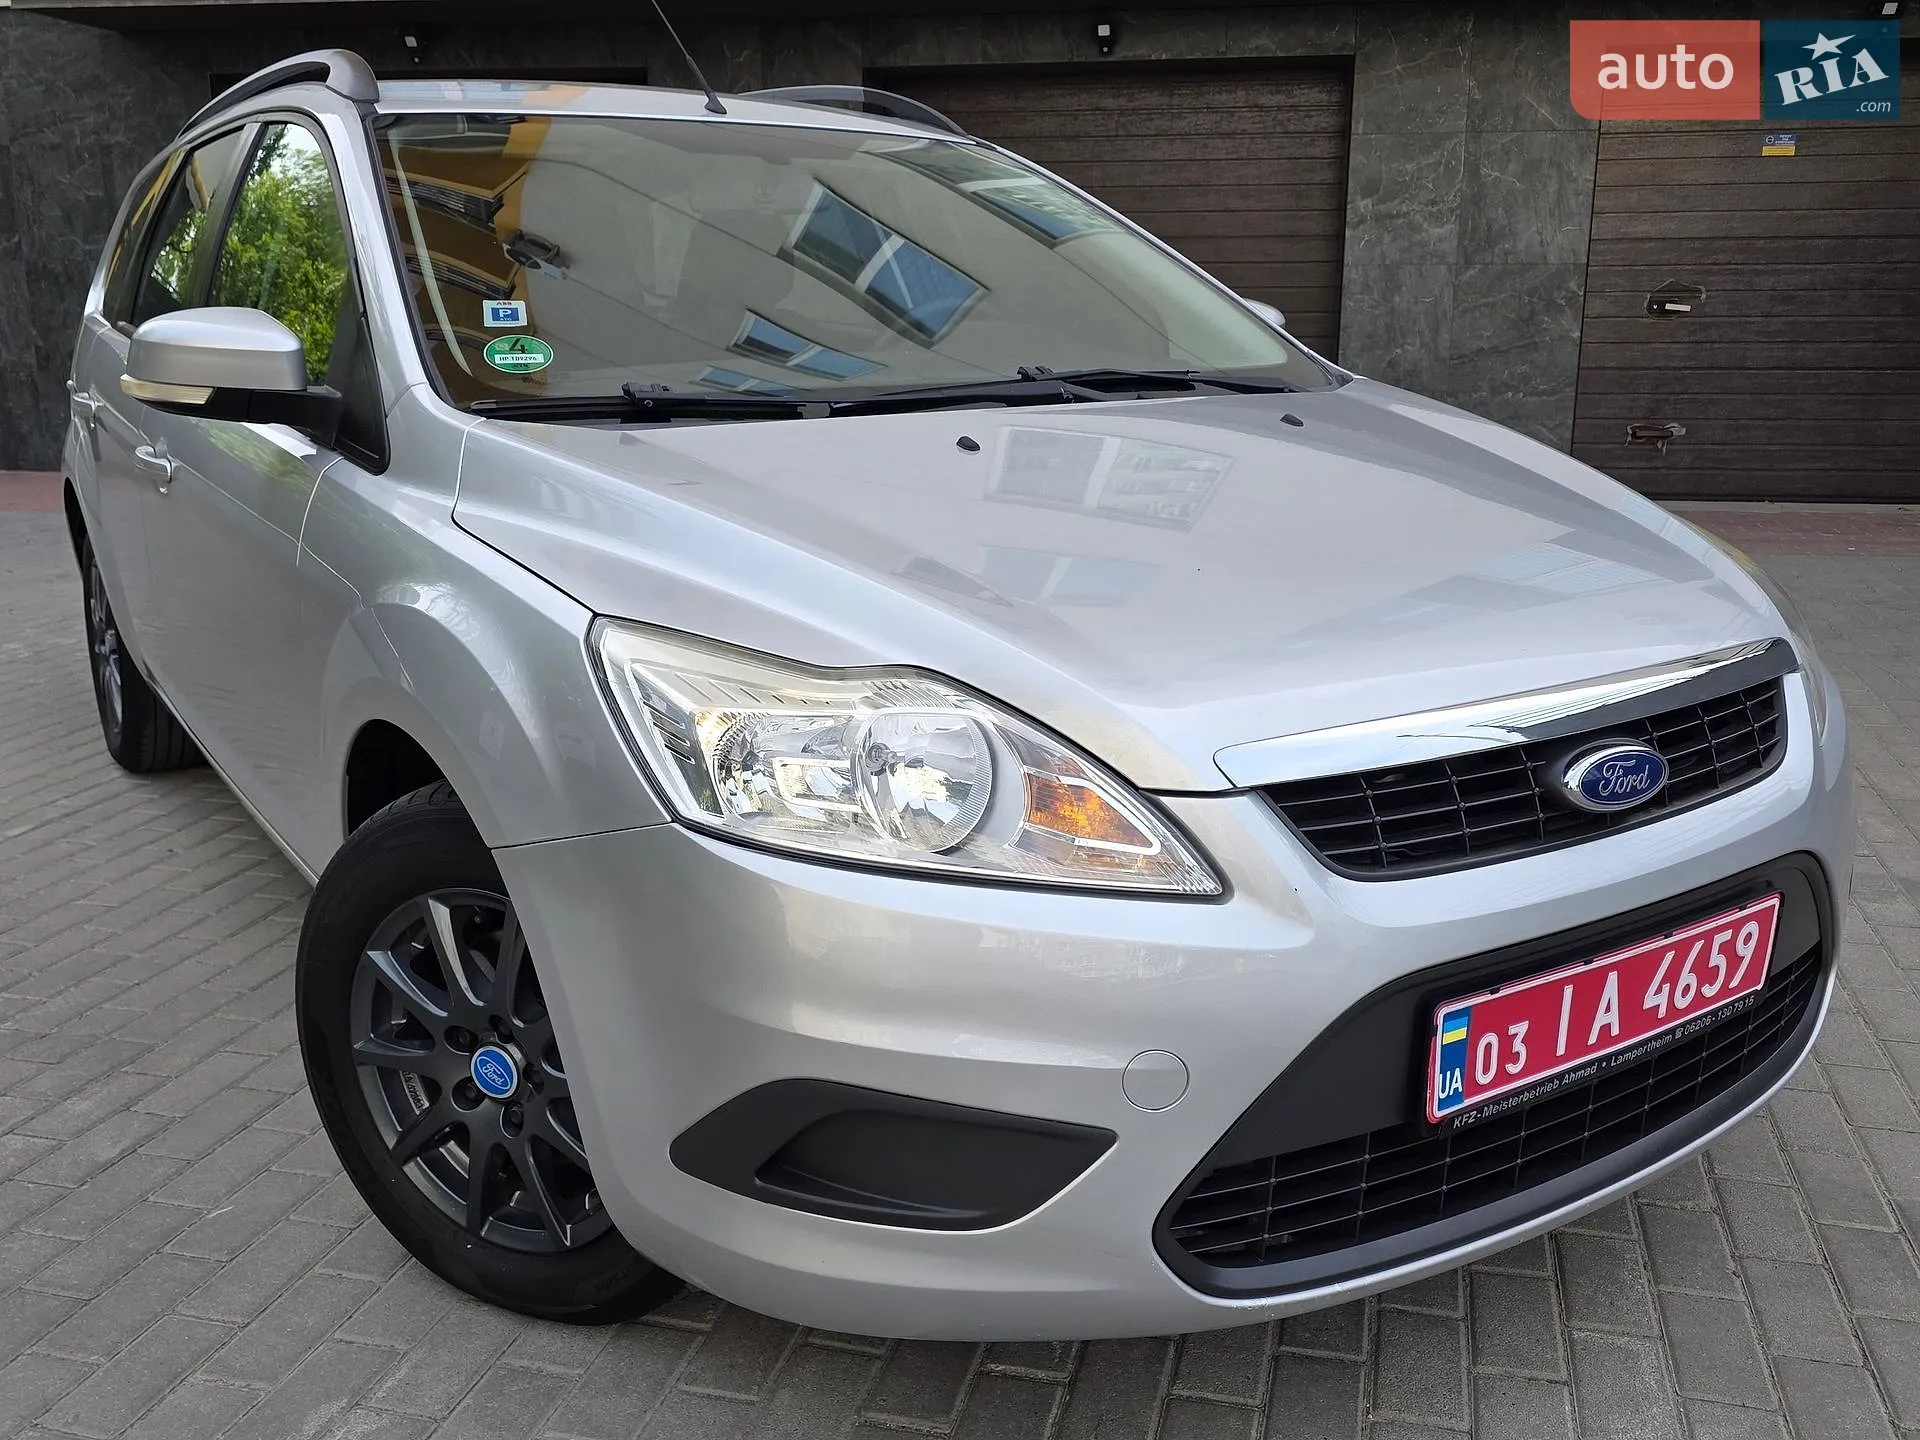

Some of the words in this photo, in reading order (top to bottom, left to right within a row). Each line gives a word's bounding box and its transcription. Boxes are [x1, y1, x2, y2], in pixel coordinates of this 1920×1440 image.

[509, 337, 527, 354] 4
[1599, 759, 1650, 796] Ford
[1475, 1020, 1529, 1085] 03
[1642, 921, 1759, 1019] 4659
[482, 1062, 505, 1086] Ford
[1438, 1067, 1463, 1099] UA
[1453, 1078, 1559, 1129] KFZ-Meisterbetrieb
[1562, 1062, 1598, 1086] Ahmad
[1610, 1034, 1672, 1067] Lampertheim
